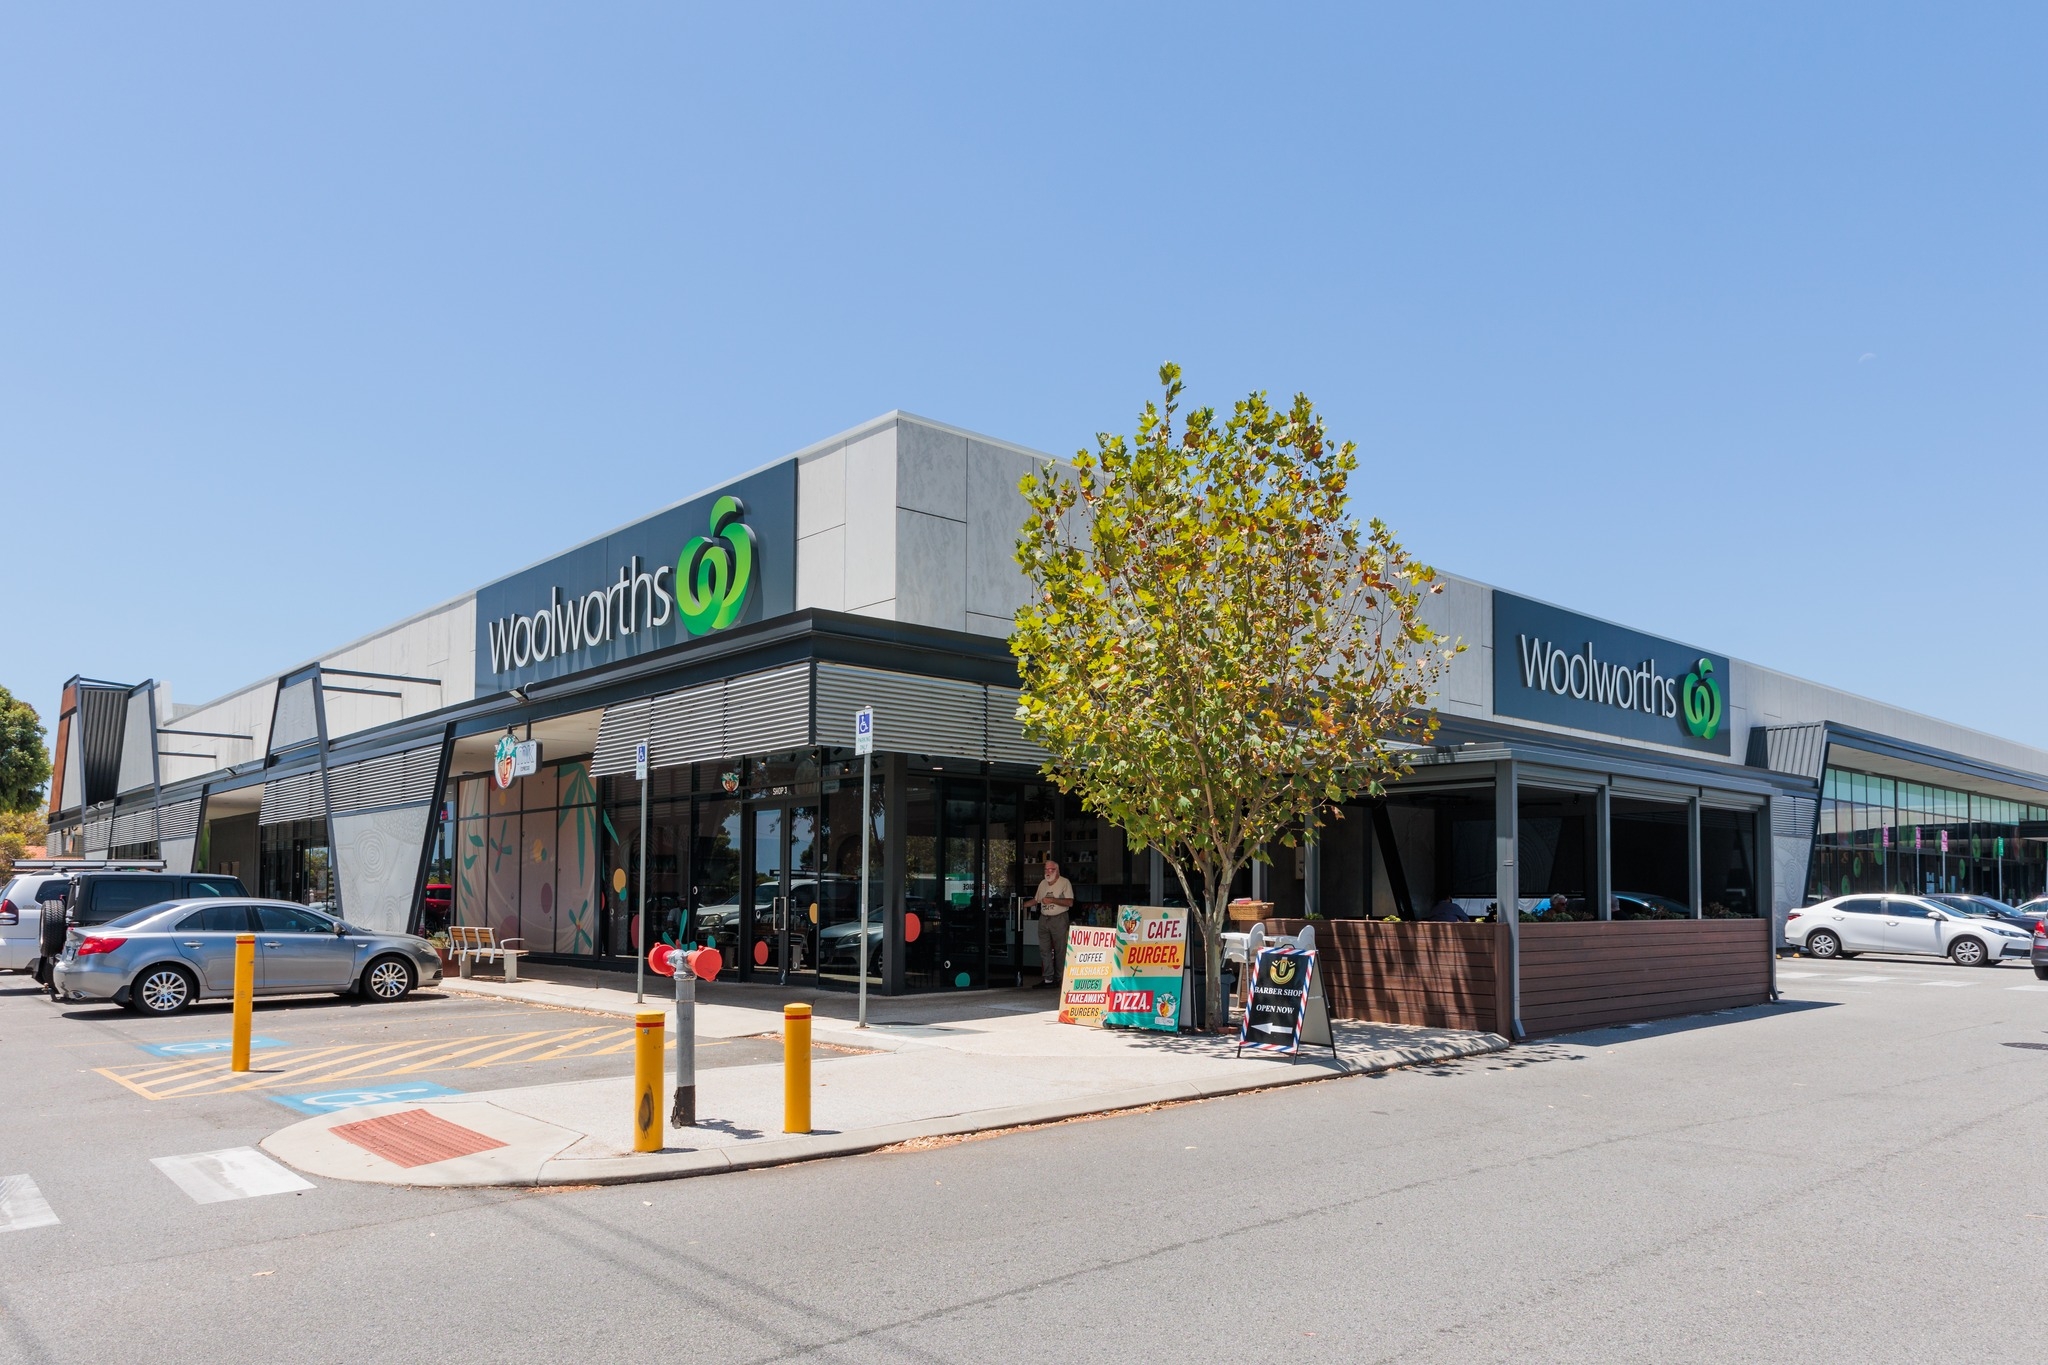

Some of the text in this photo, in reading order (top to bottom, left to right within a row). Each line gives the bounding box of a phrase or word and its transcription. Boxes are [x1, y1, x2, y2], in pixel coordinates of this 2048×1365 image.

[489, 555, 673, 675] Woolworths
[1520, 634, 1677, 719] Woolworths
[772, 787, 783, 796] SHOP
[1147, 920, 1182, 939] CAFE.
[1070, 930, 1117, 948] NOW OPEN
[1079, 953, 1103, 963] COFFEE
[1127, 945, 1180, 964] BURGER.
[1069, 966, 1110, 976] MILKSHAKES
[1076, 980, 1099, 990] JUICES
[1254, 986, 1303, 997] BARBER SHOP
[1067, 993, 1105, 1003] TAKEAWAYS
[1112, 992, 1151, 1011] PIZZA.
[1070, 1007, 1100, 1017] BURGERS
[1256, 1004, 1295, 1014] OPEN NOW
